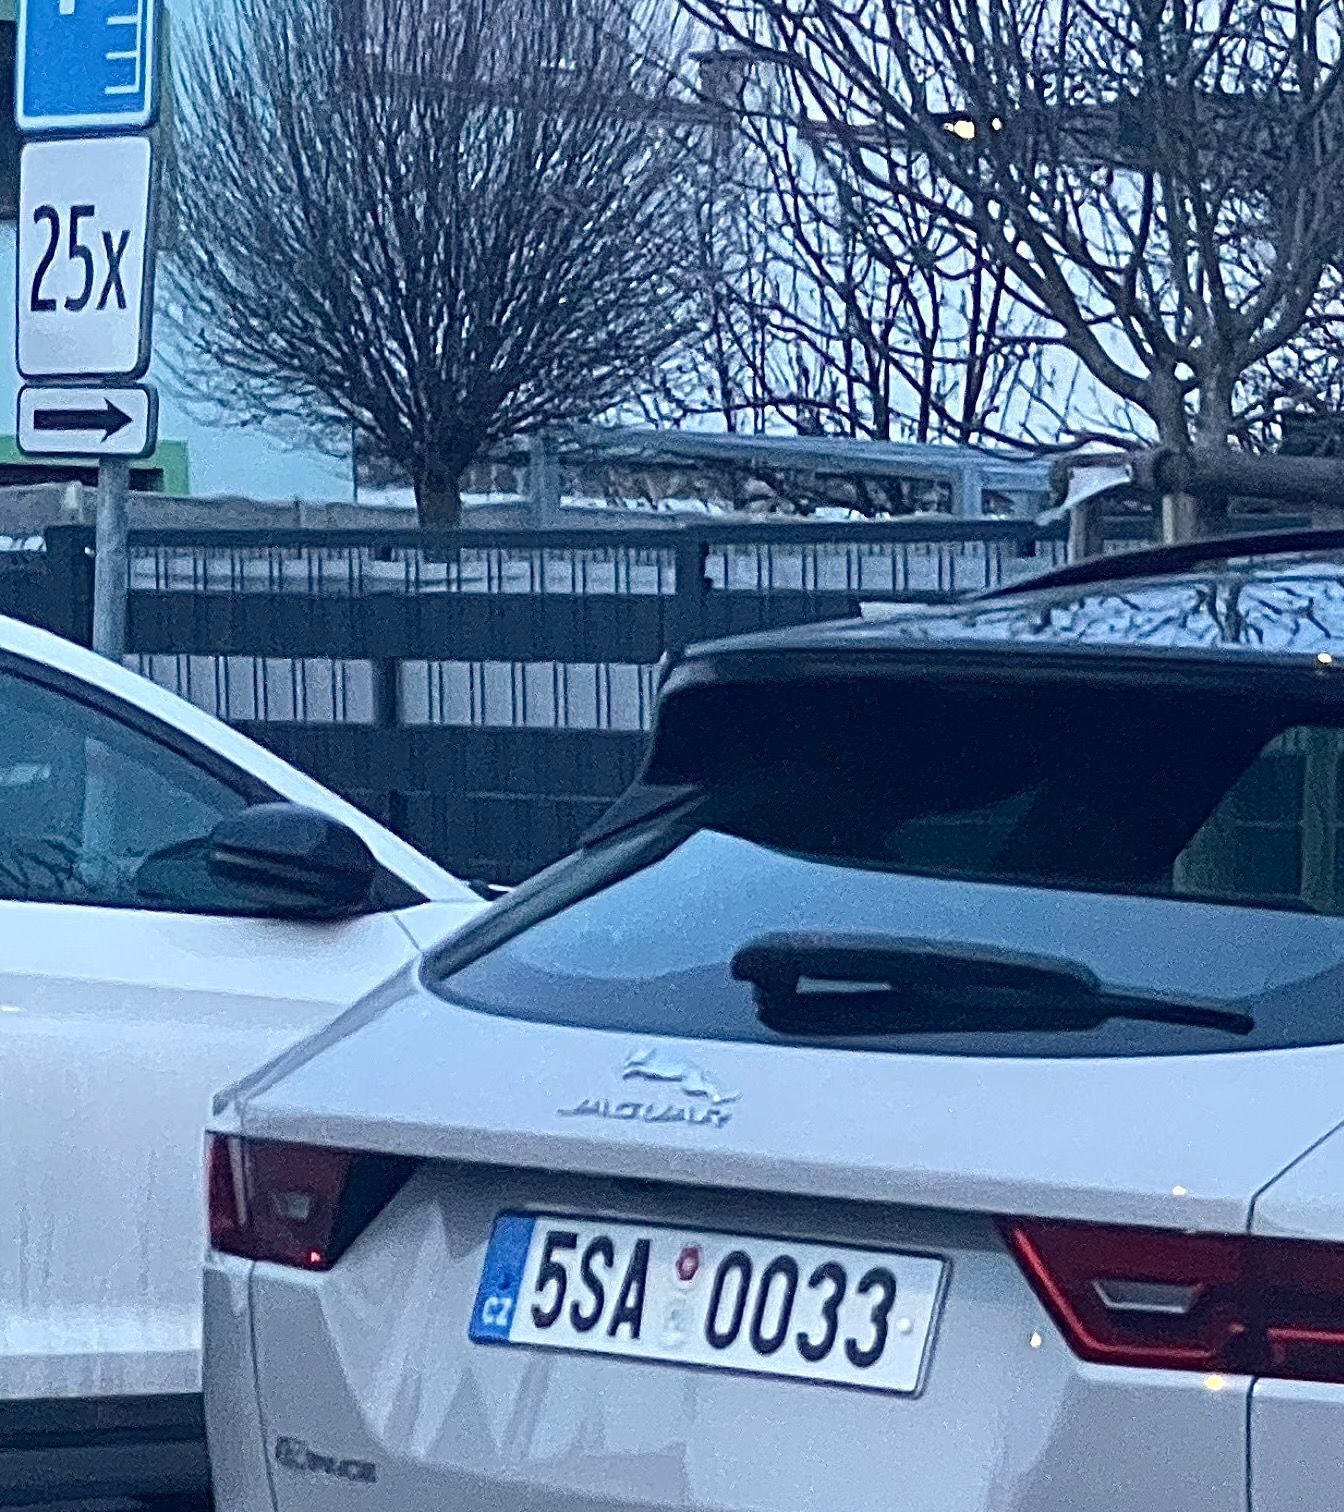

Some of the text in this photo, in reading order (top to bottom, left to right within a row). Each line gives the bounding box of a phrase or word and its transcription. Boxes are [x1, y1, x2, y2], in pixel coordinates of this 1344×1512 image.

[30, 204, 130, 312] 25x
[481, 1296, 512, 1327] CZ
[530, 1231, 898, 1369] 5SA 0033
